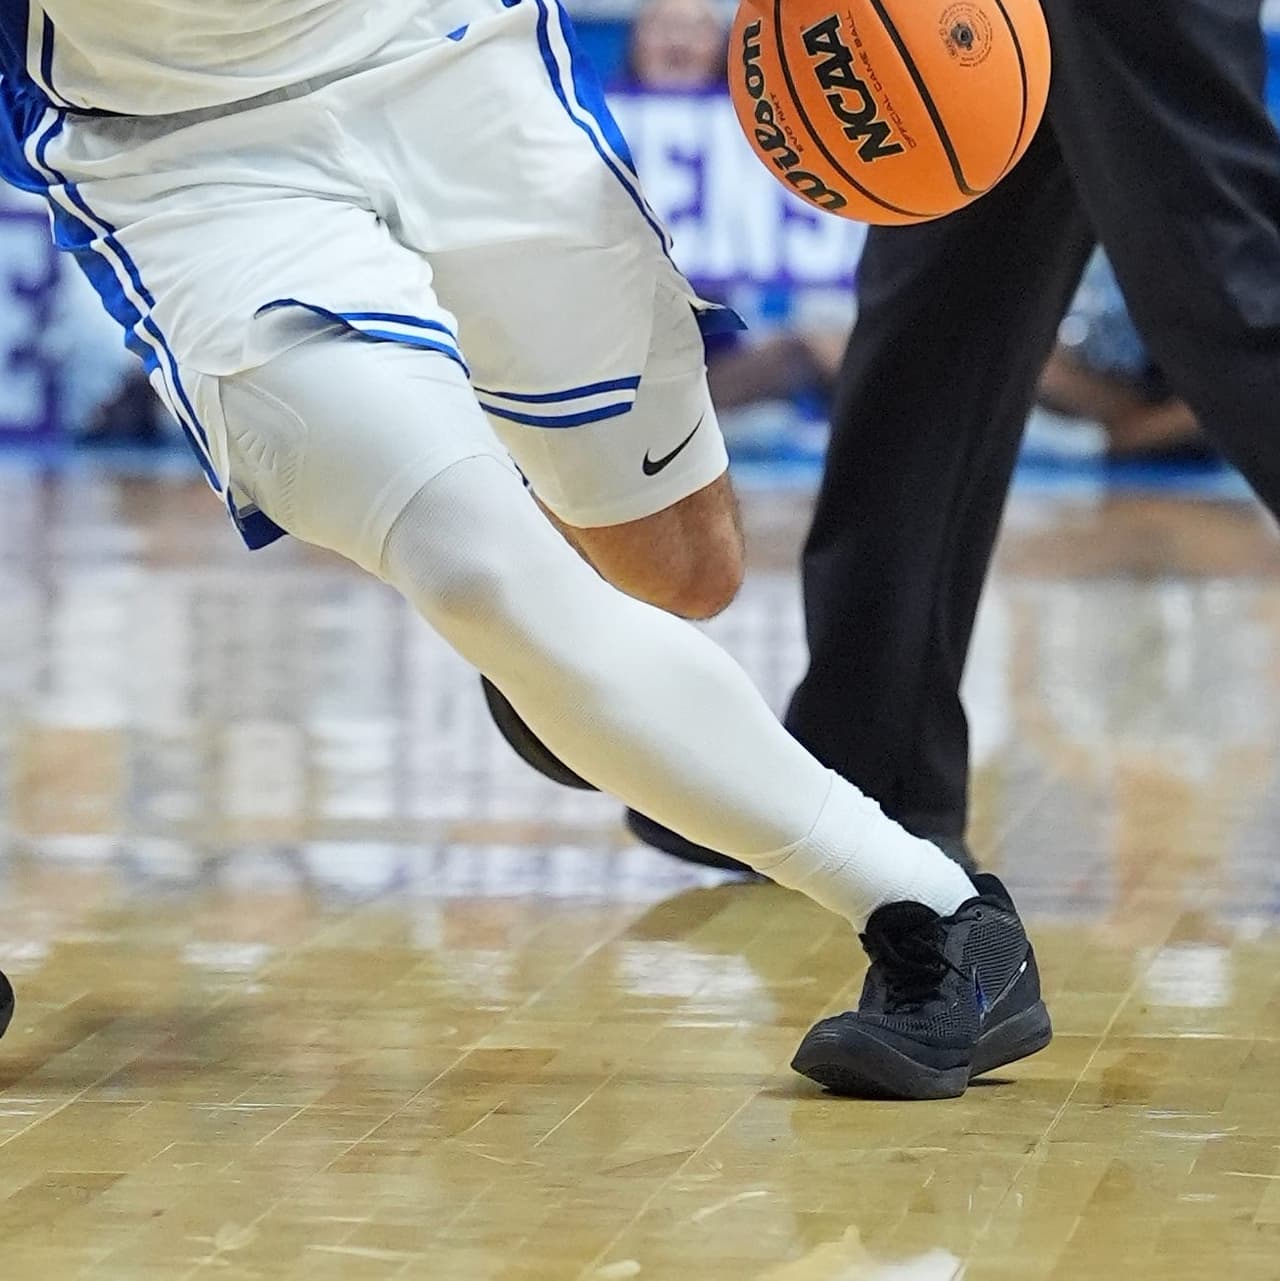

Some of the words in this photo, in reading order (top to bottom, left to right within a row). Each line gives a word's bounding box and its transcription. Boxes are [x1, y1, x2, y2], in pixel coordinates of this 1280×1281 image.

[846, 9, 863, 48] BALL
[801, 13, 906, 163] NCAA
[858, 51, 883, 93] GAME
[742, 19, 848, 213] Wilson
[784, 125, 804, 153] EVO
[883, 94, 917, 149] OFFICIAL
